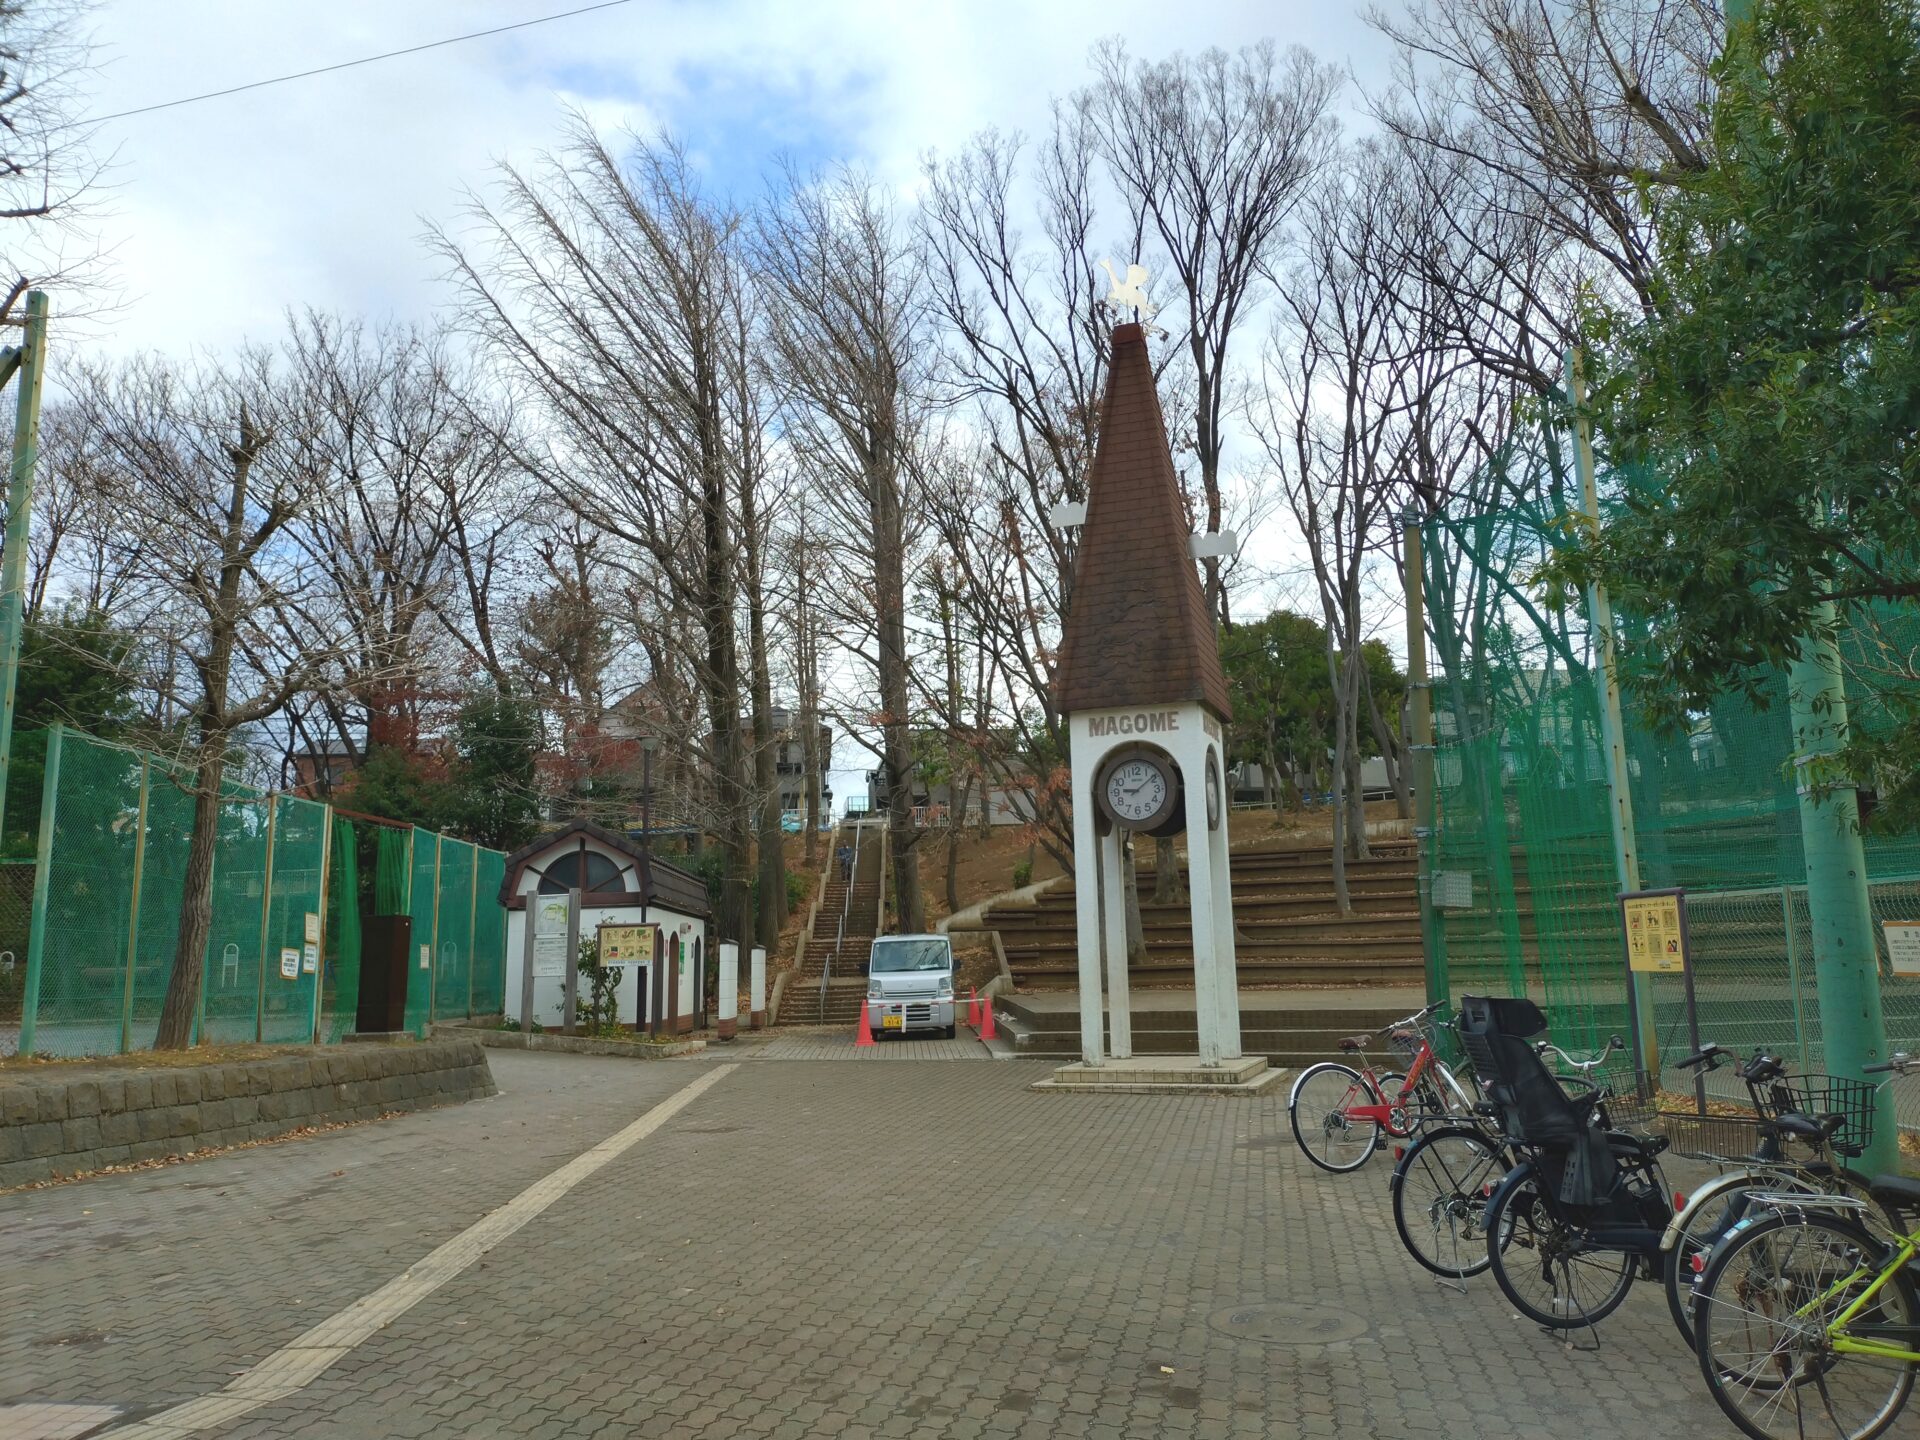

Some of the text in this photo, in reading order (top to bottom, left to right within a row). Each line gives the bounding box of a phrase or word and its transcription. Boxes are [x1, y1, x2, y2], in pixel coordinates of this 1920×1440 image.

[1088, 711, 1179, 737] MAGOME
[1122, 767, 1131, 779] 11
[1131, 766, 1141, 776] 12
[1113, 777, 1125, 787] 10
[1151, 773, 1158, 784] 2
[1113, 788, 1120, 797] 9
[1153, 784, 1161, 794] 3
[1117, 797, 1124, 806] 8
[1151, 795, 1159, 803] 4
[1125, 804, 1132, 813] 7
[1134, 805, 1141, 815] 6
[1144, 802, 1151, 811] 5
